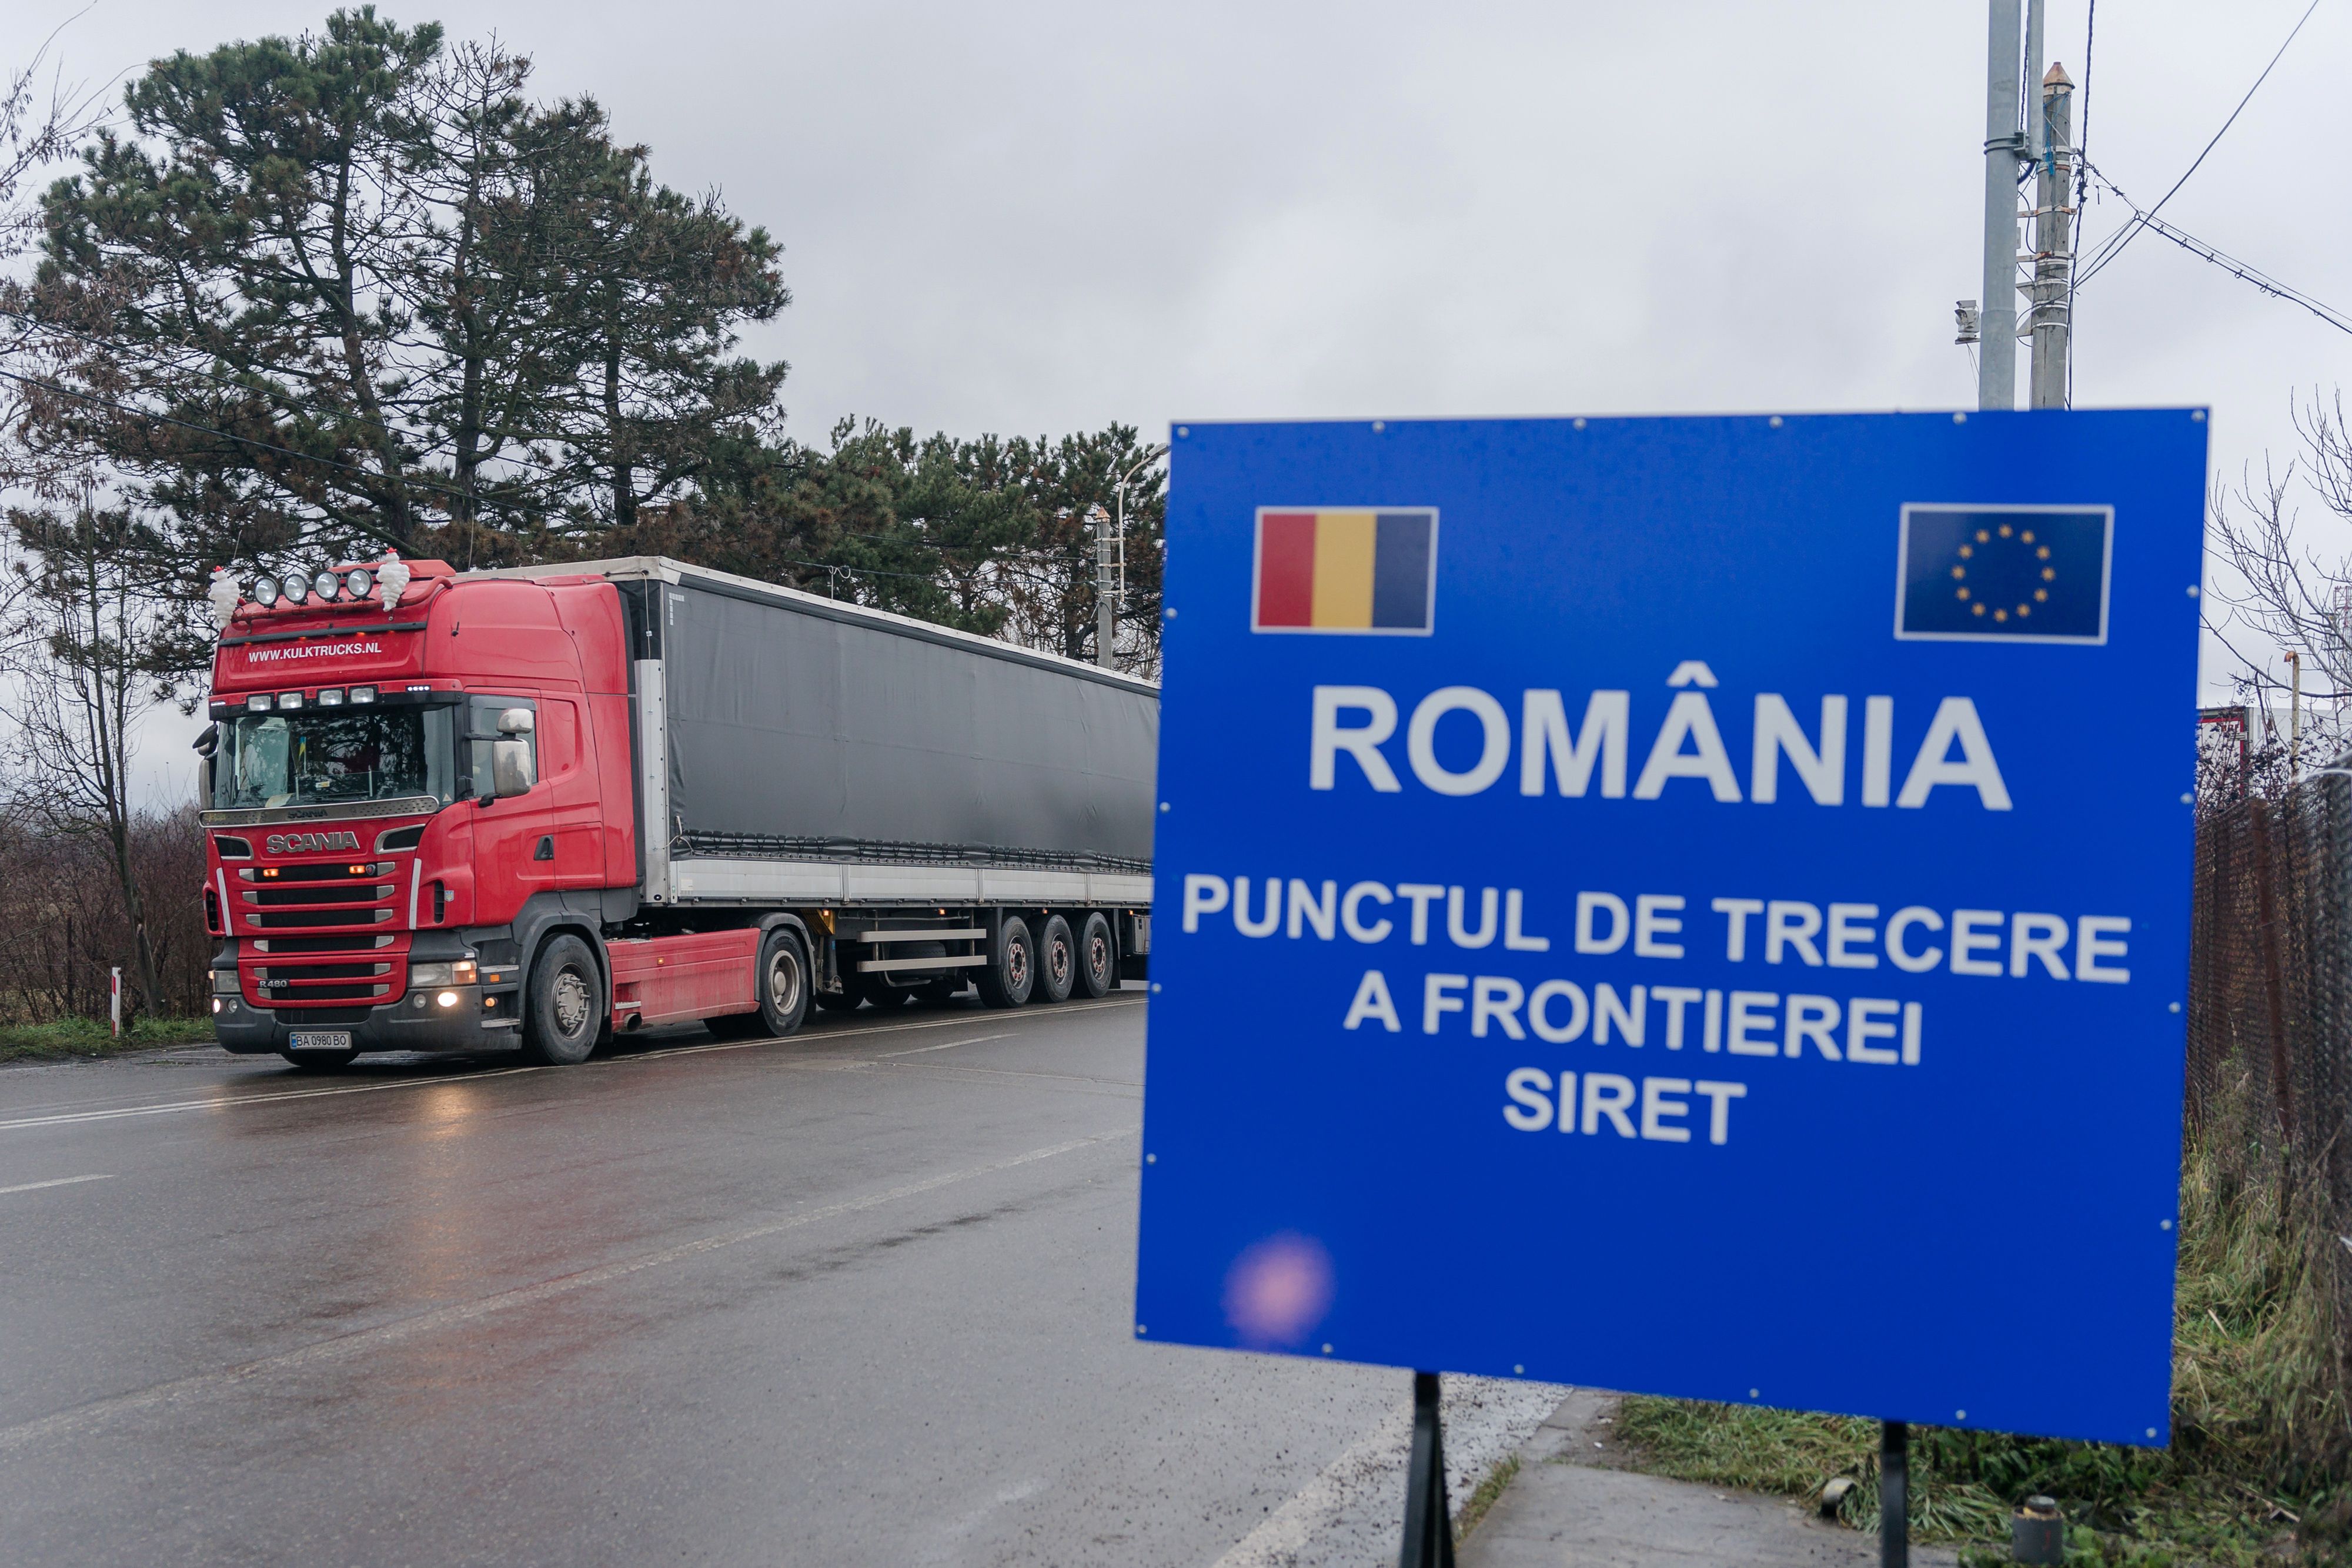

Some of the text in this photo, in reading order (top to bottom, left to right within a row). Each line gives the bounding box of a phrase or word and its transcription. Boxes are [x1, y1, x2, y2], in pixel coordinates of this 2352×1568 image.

[248, 643, 382, 663] WWW.KULKTRUCKS.NL
[1310, 661, 2012, 810] ROMÂNIA
[266, 831, 360, 854] SCANIA
[1183, 874, 2131, 983] PUNCTUL DE TRECERE
[296, 1036, 309, 1046] BA
[312, 1035, 332, 1046] 0980
[333, 1035, 346, 1045] BO
[1344, 971, 1922, 1065] A FRONTIEREI
[1504, 1068, 1746, 1144] SIRET
